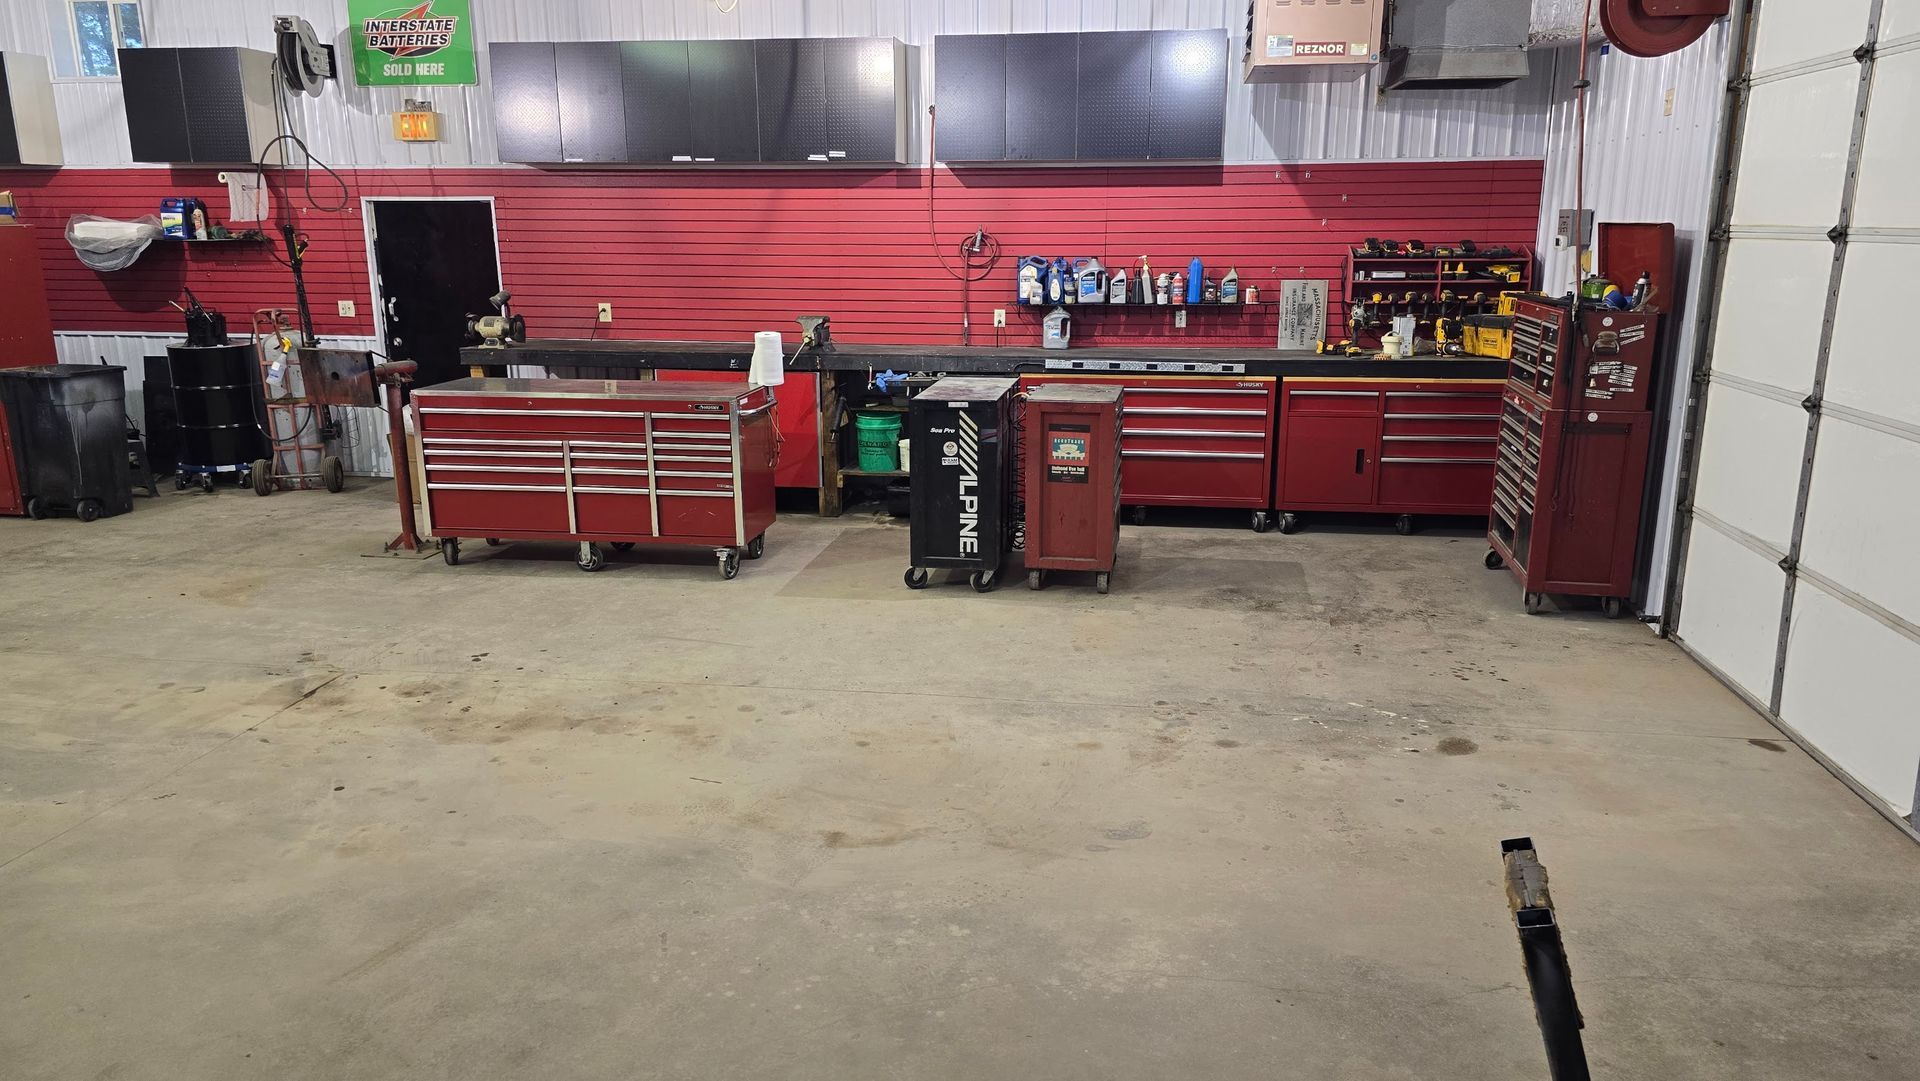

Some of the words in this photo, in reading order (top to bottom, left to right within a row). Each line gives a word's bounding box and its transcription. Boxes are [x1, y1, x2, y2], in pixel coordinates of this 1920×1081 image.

[365, 20, 454, 32] INTERSTATE
[369, 34, 448, 47] BATTERIES
[1296, 44, 1344, 54] REZNOR
[383, 64, 412, 76] SOLD
[415, 63, 445, 76] HERE
[400, 113, 429, 139] EXIT
[1310, 288, 1321, 341] MASSACHUSETTS
[959, 458, 978, 553] ALPINE
